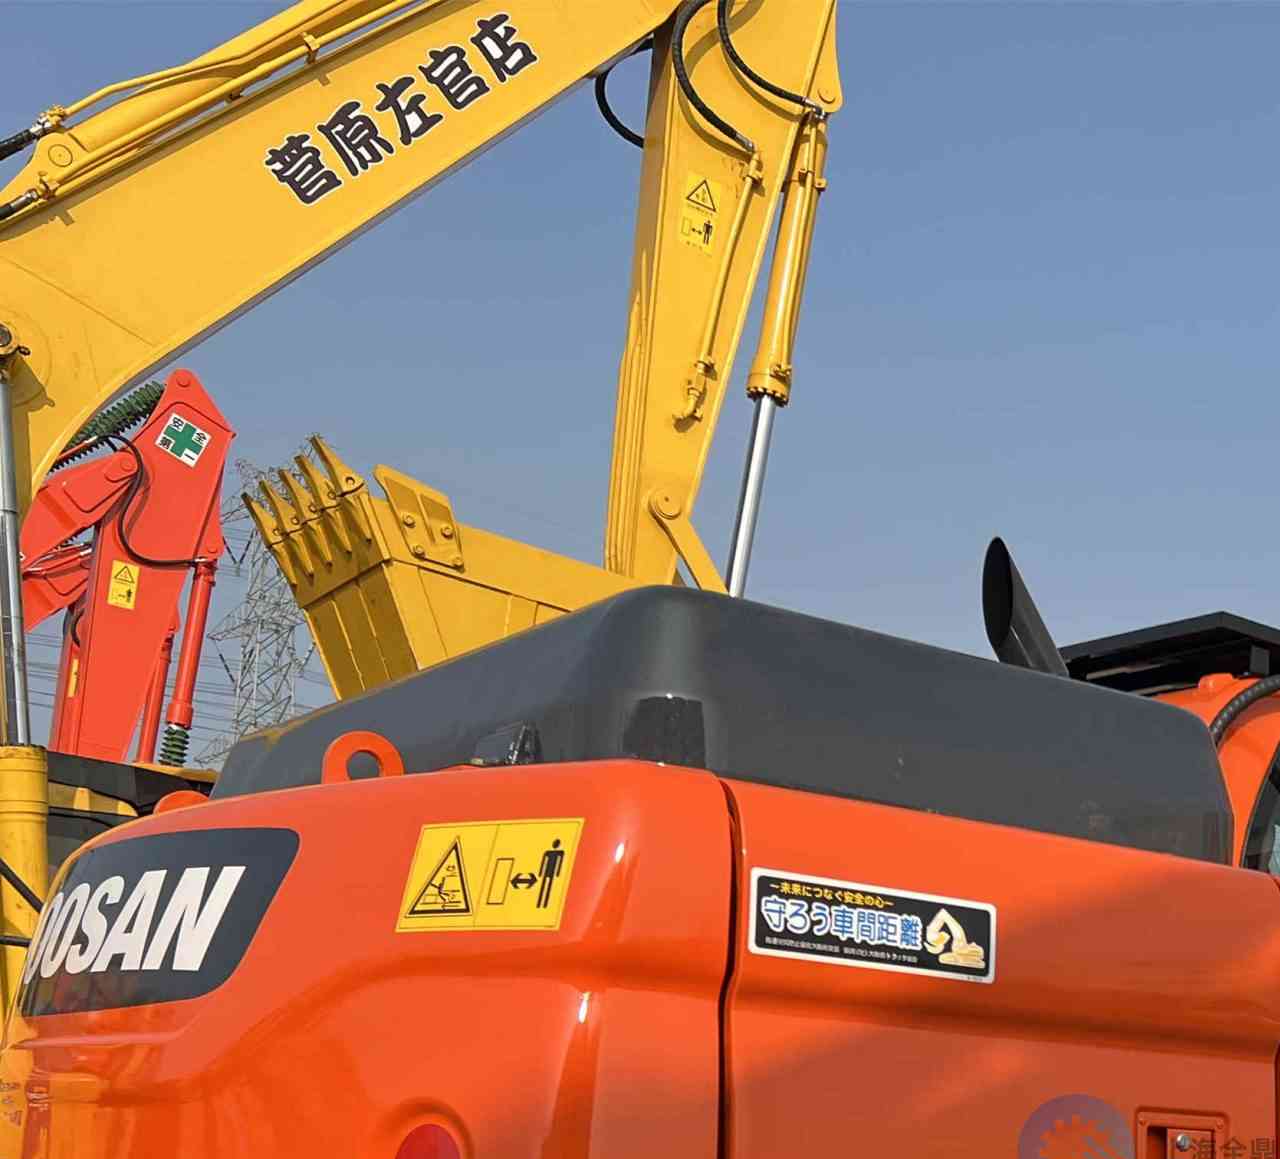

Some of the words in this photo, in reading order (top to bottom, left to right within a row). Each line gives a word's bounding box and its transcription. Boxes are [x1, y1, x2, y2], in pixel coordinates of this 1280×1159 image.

[762, 897, 922, 950] 守ろう車間距離
